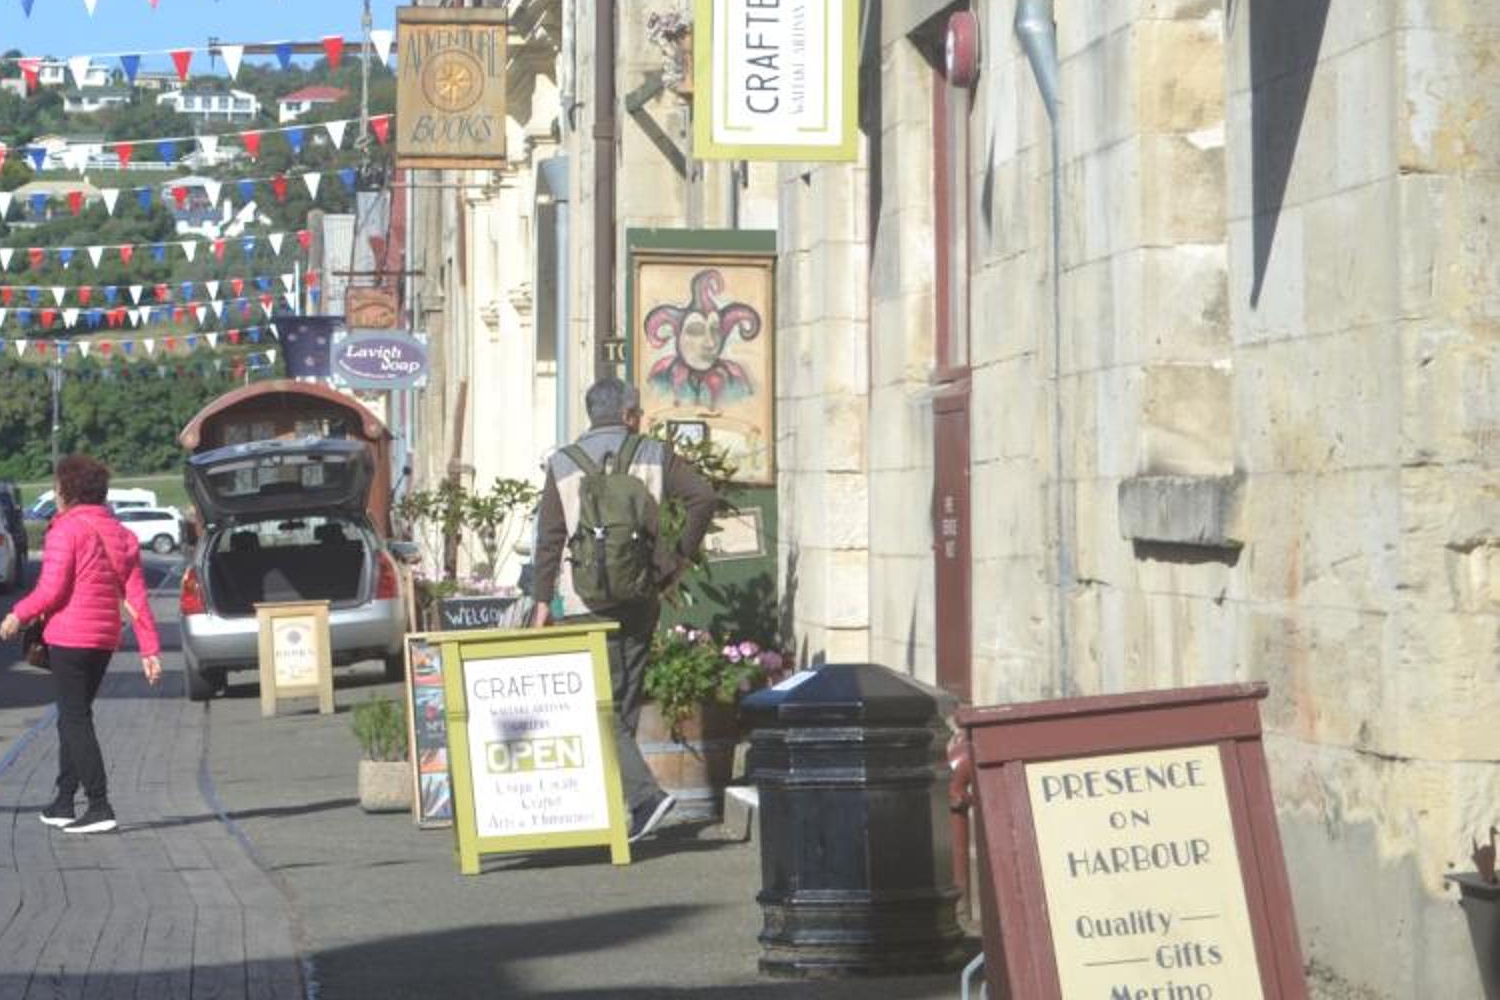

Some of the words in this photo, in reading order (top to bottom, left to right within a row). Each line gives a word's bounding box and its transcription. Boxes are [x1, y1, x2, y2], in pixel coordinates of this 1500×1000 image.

[409, 114, 495, 145] BOOKS
[346, 345, 403, 359] Lavish
[381, 351, 420, 374] Soap
[473, 671, 583, 701] CRAFTED
[488, 737, 583, 772] OPEN
[1041, 759, 1205, 803] PRESENCE
[1109, 809, 1151, 829] ON
[1067, 839, 1211, 878] HARBOUR
[1075, 910, 1173, 940] Quality
[1155, 942, 1223, 970] Gifts
